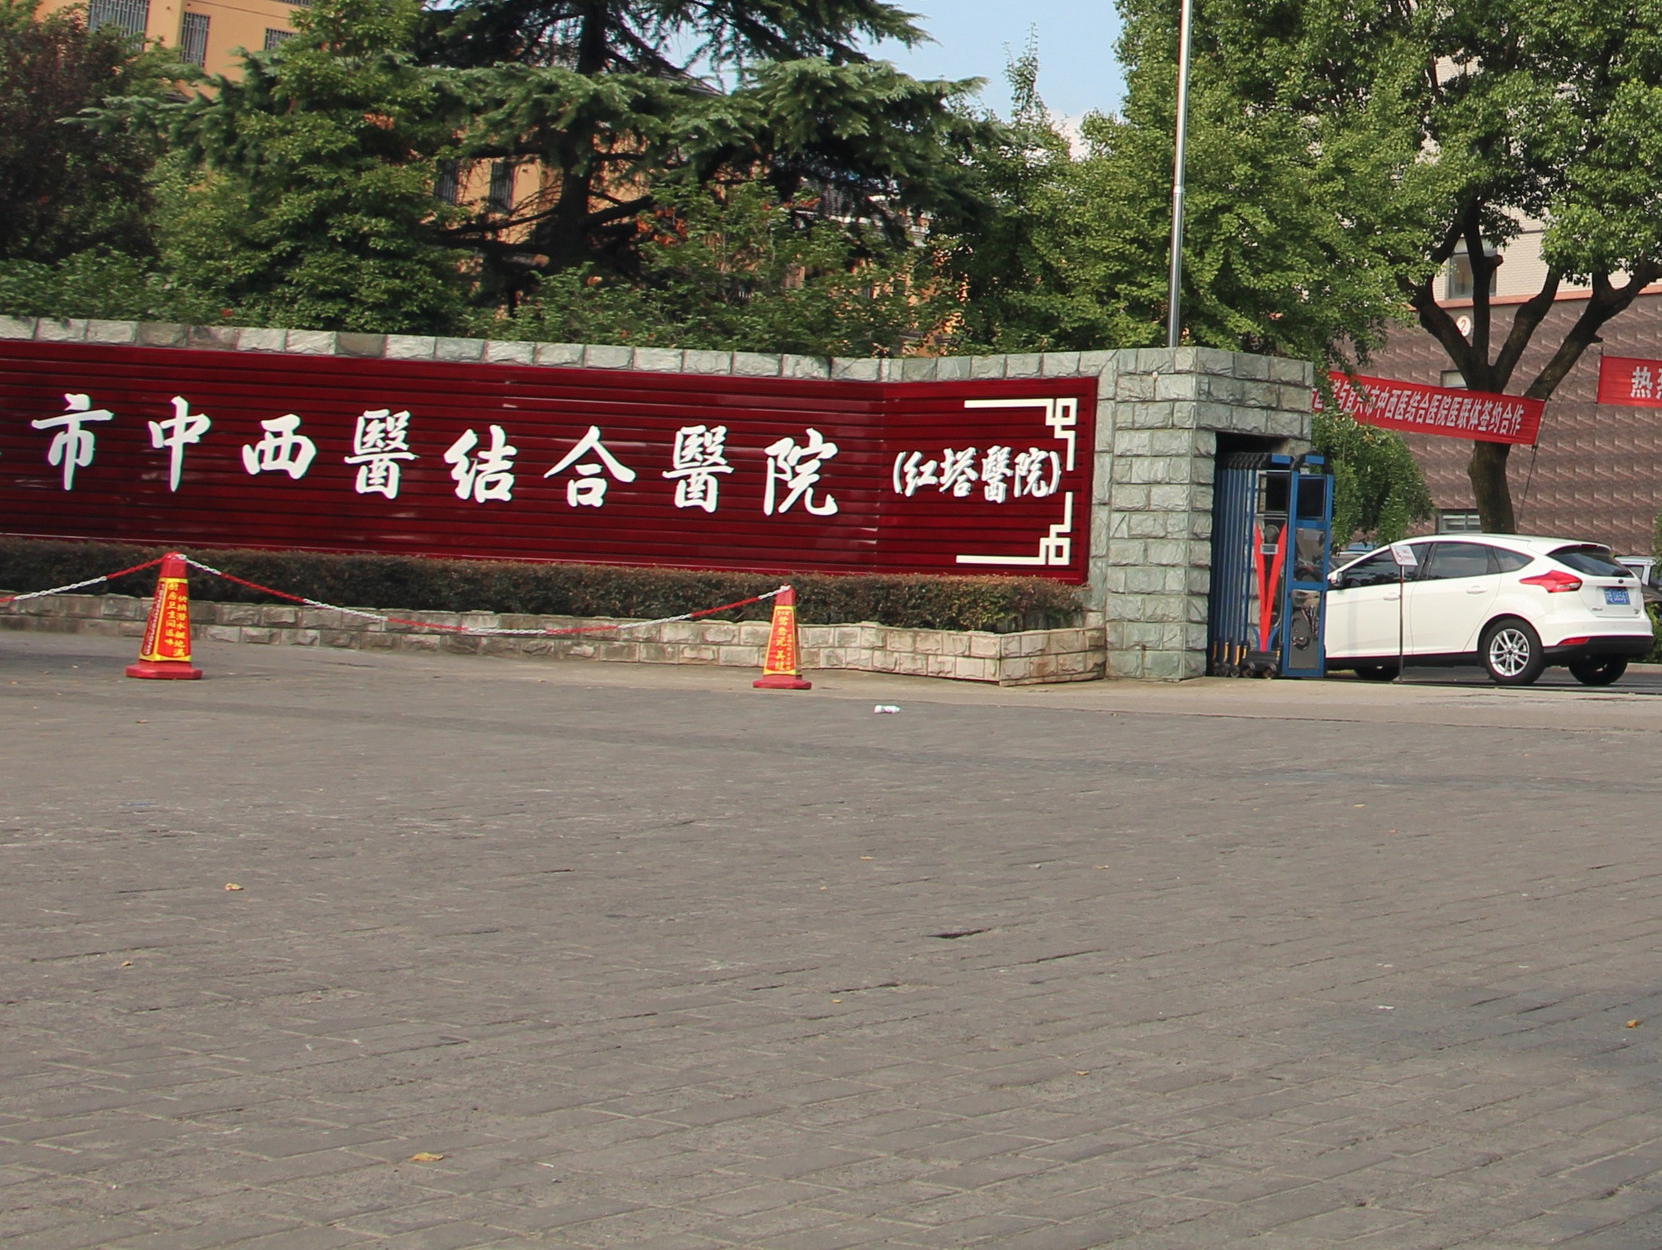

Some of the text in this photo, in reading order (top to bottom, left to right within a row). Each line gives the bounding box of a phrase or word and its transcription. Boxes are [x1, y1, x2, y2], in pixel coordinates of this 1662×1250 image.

[1312, 377, 1525, 437] 医与宜兴市中西医结合医院医联体签约合作
